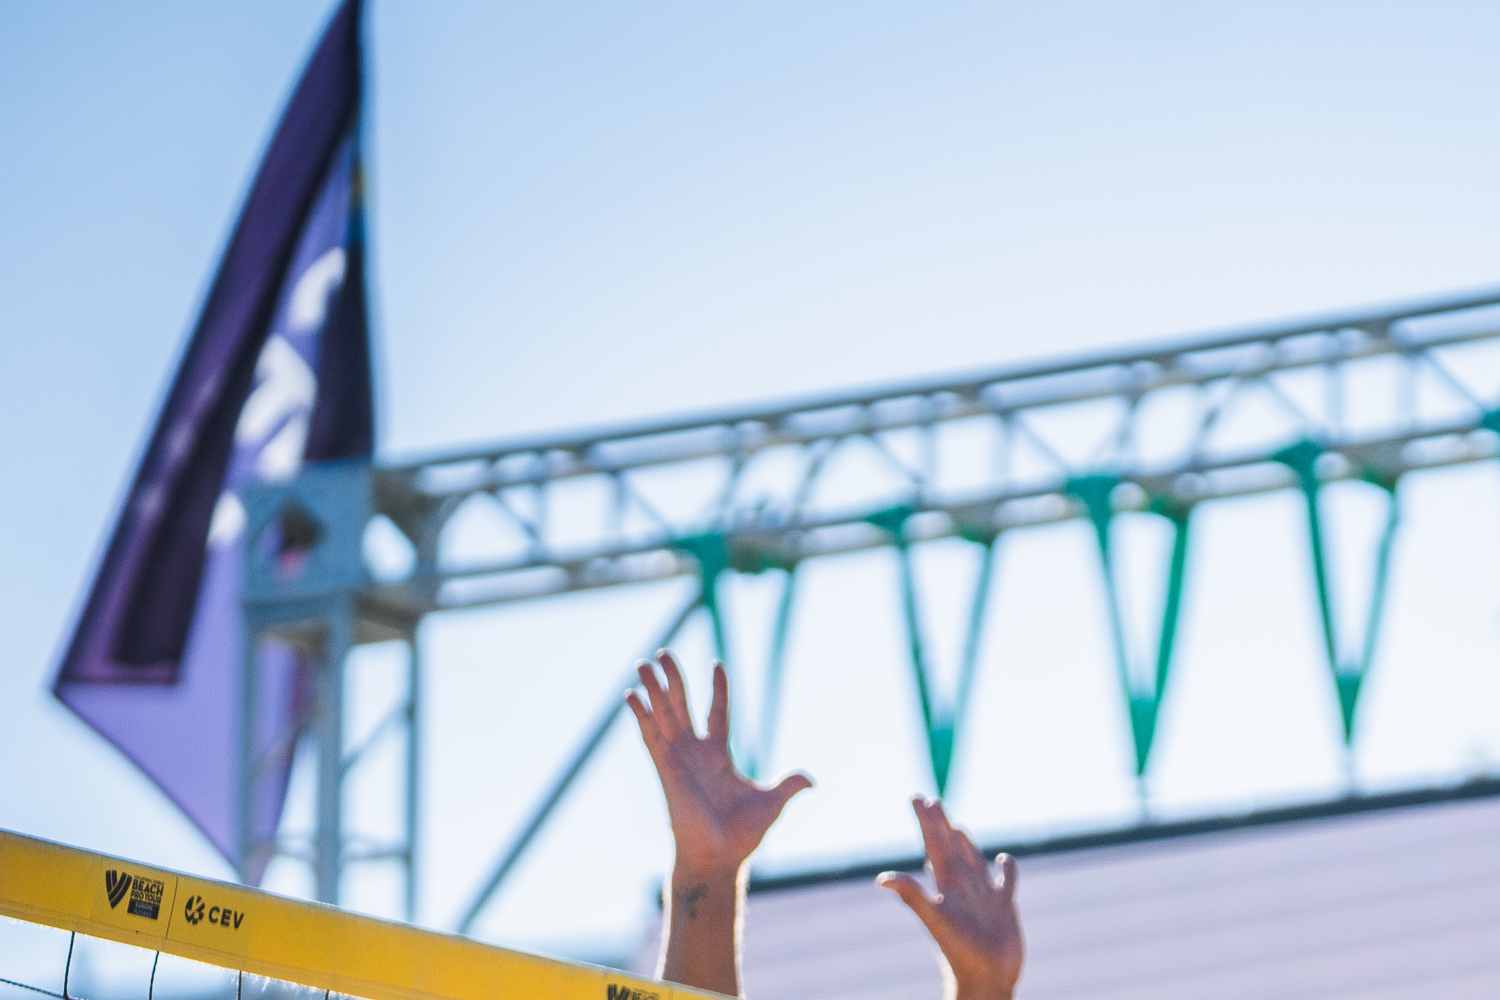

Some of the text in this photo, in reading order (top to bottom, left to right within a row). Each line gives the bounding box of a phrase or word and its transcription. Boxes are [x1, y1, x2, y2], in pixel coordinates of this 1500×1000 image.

[132, 879, 164, 896] BEACH
[130, 889, 162, 905] PRO TOUR
[208, 905, 245, 930] CEV
